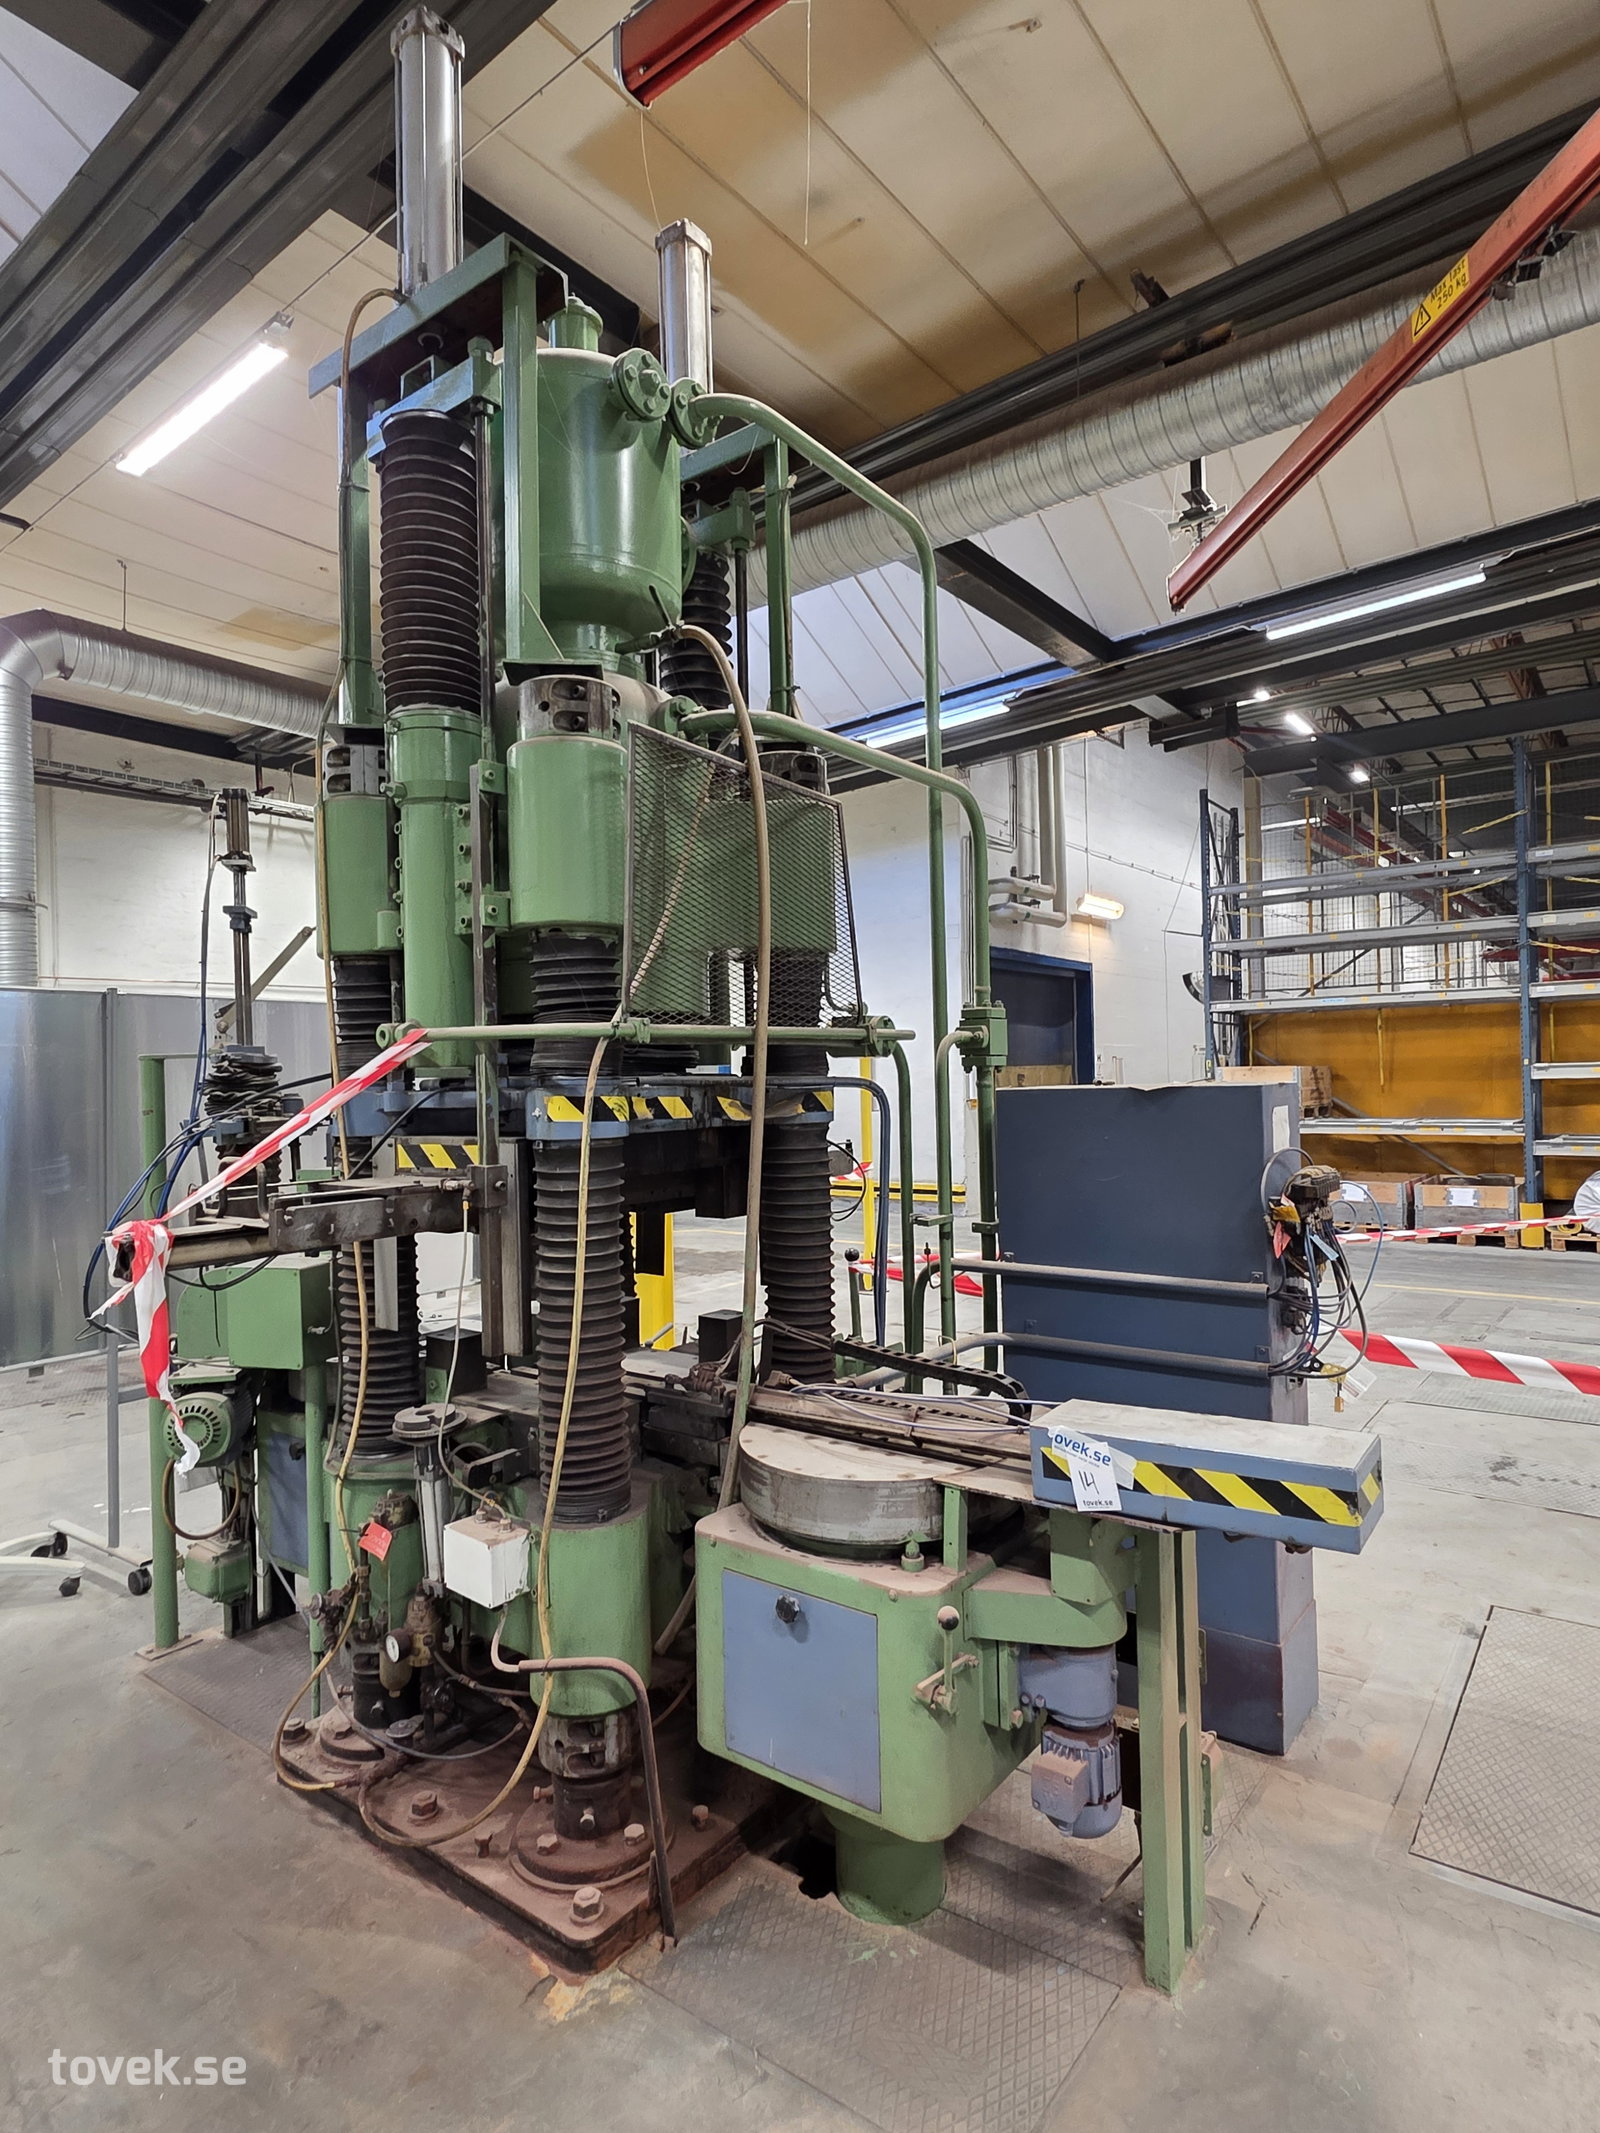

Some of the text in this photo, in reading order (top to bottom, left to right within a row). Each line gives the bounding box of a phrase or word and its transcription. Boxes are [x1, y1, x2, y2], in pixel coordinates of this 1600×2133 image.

[1430, 258, 1466, 304] Max last
[1437, 272, 1469, 310] 250 kg
[1078, 1470, 1100, 1496] 14
[1082, 1499, 1114, 1507] tovek.se
